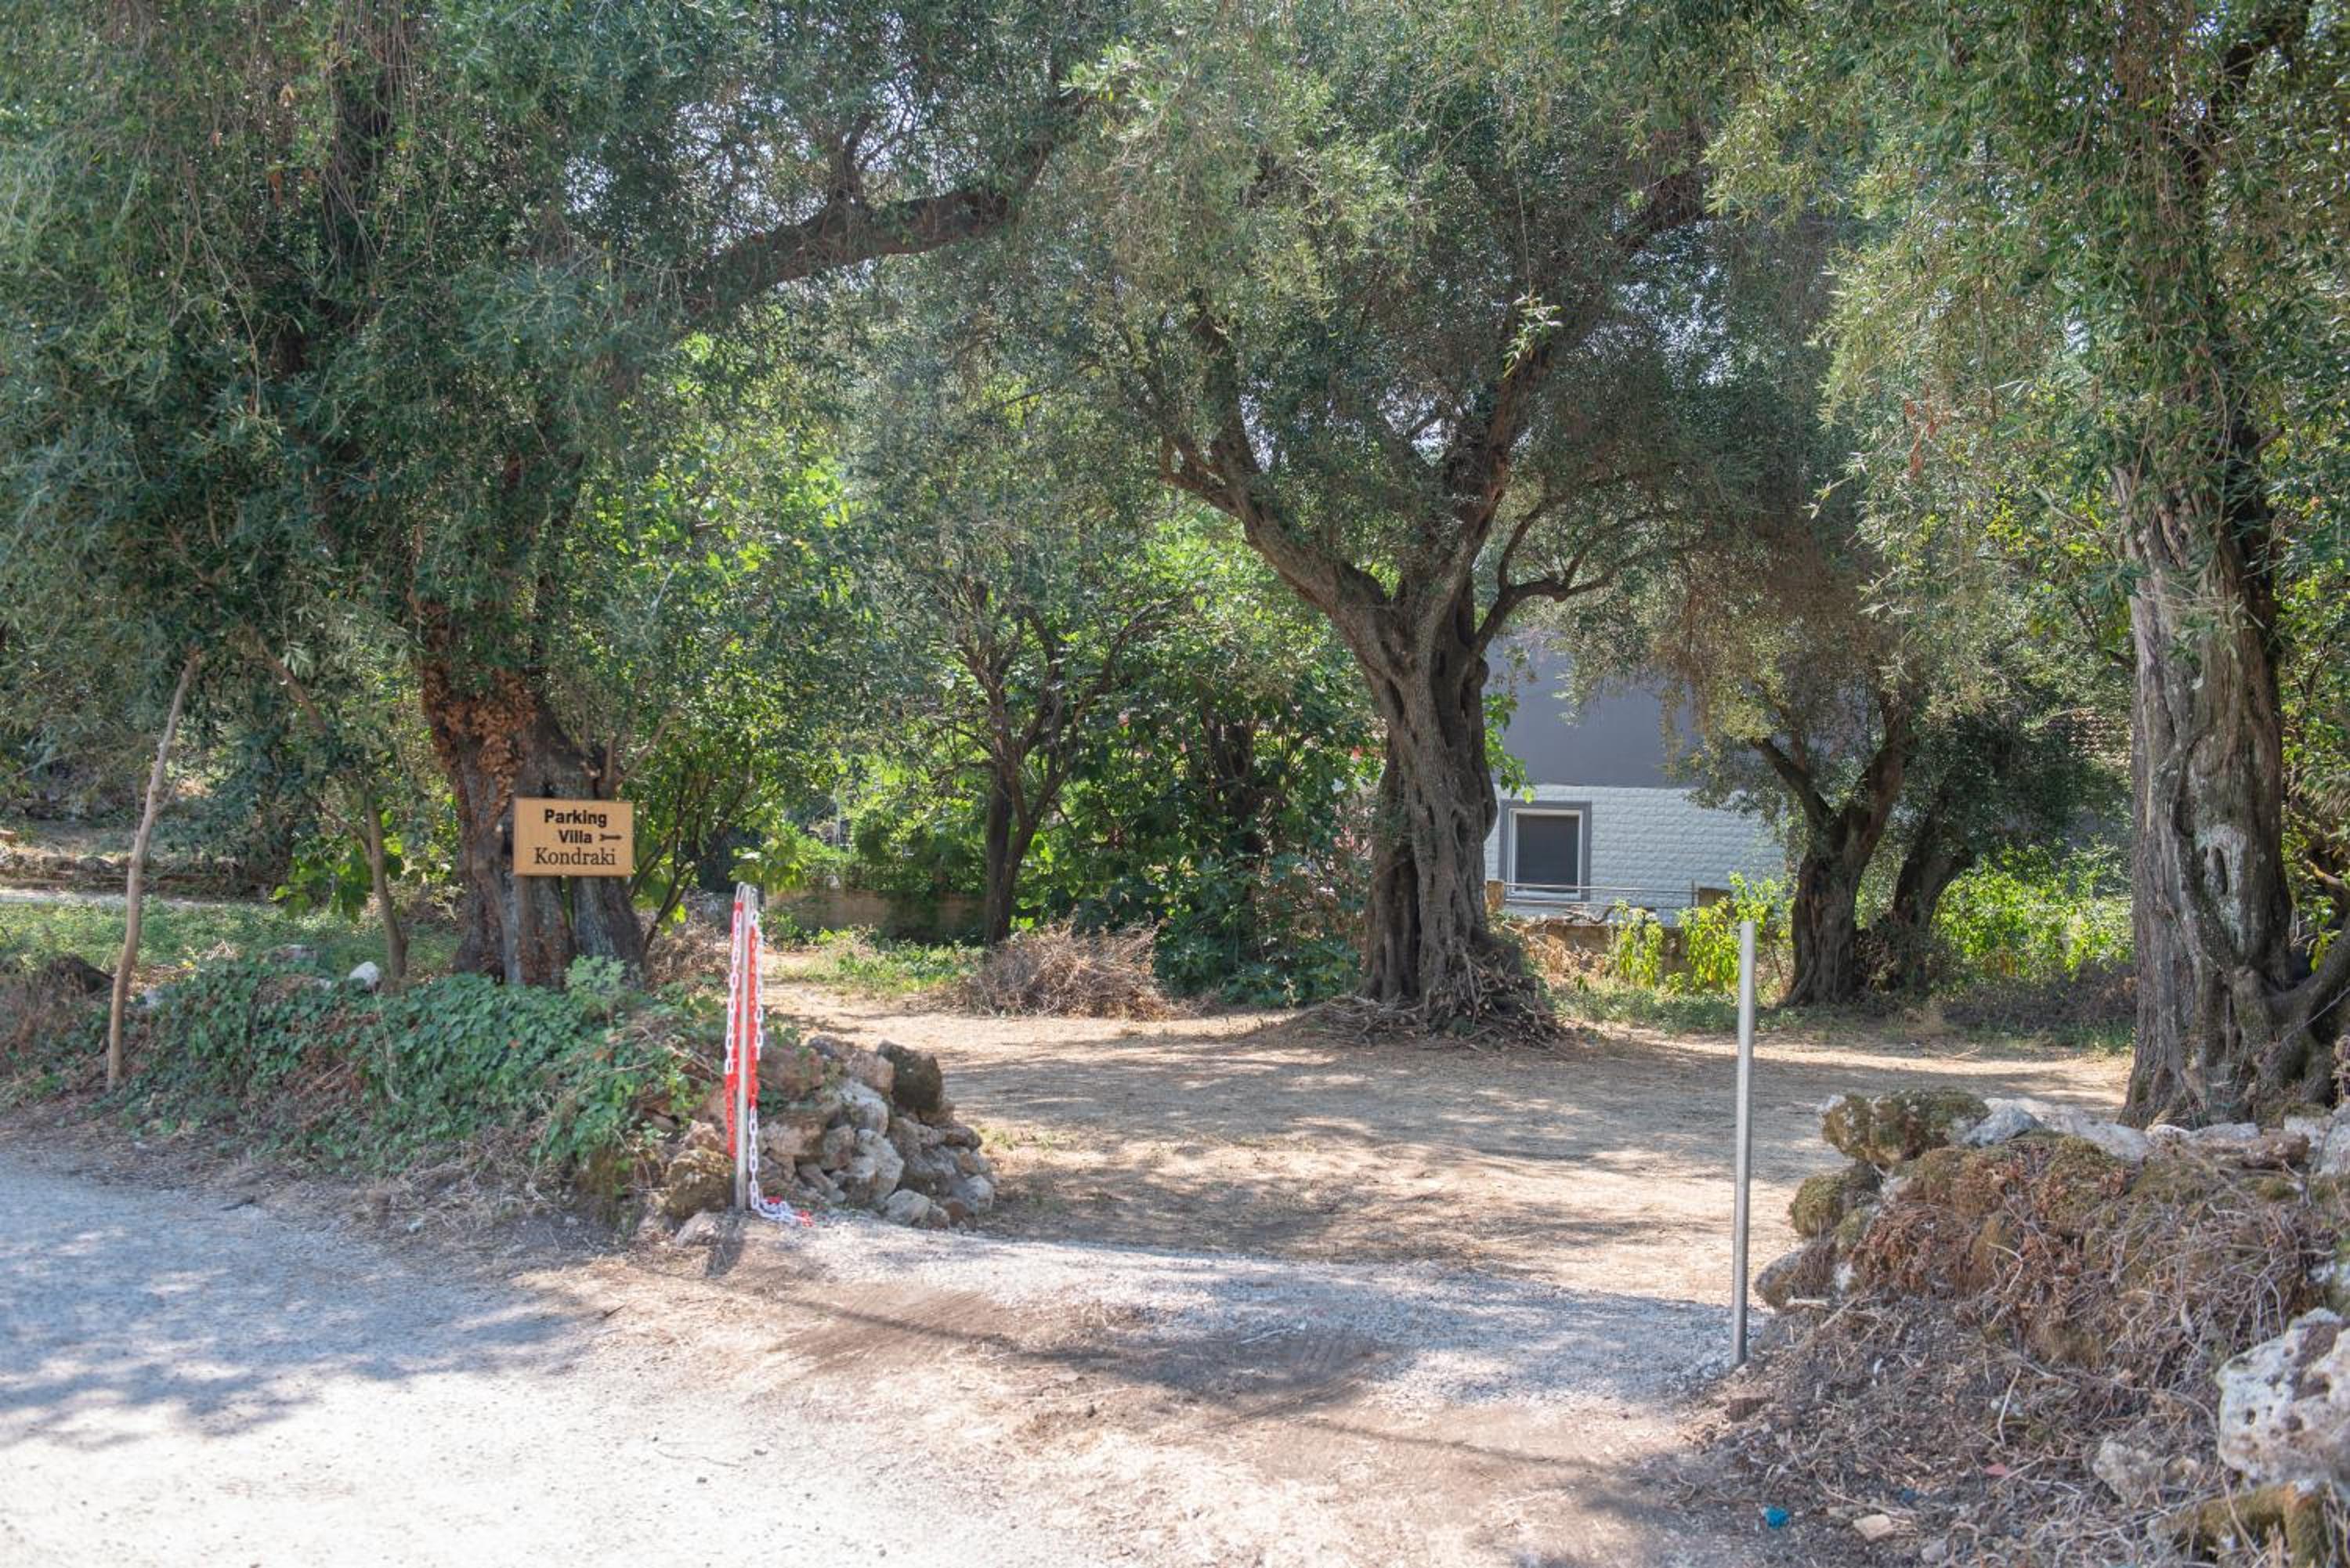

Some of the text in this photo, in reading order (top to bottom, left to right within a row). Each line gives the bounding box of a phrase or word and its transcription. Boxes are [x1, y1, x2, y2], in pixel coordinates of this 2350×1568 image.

[544, 809, 607, 828] Parking
[559, 829, 592, 844] Villa
[534, 847, 616, 865] Kondraki
